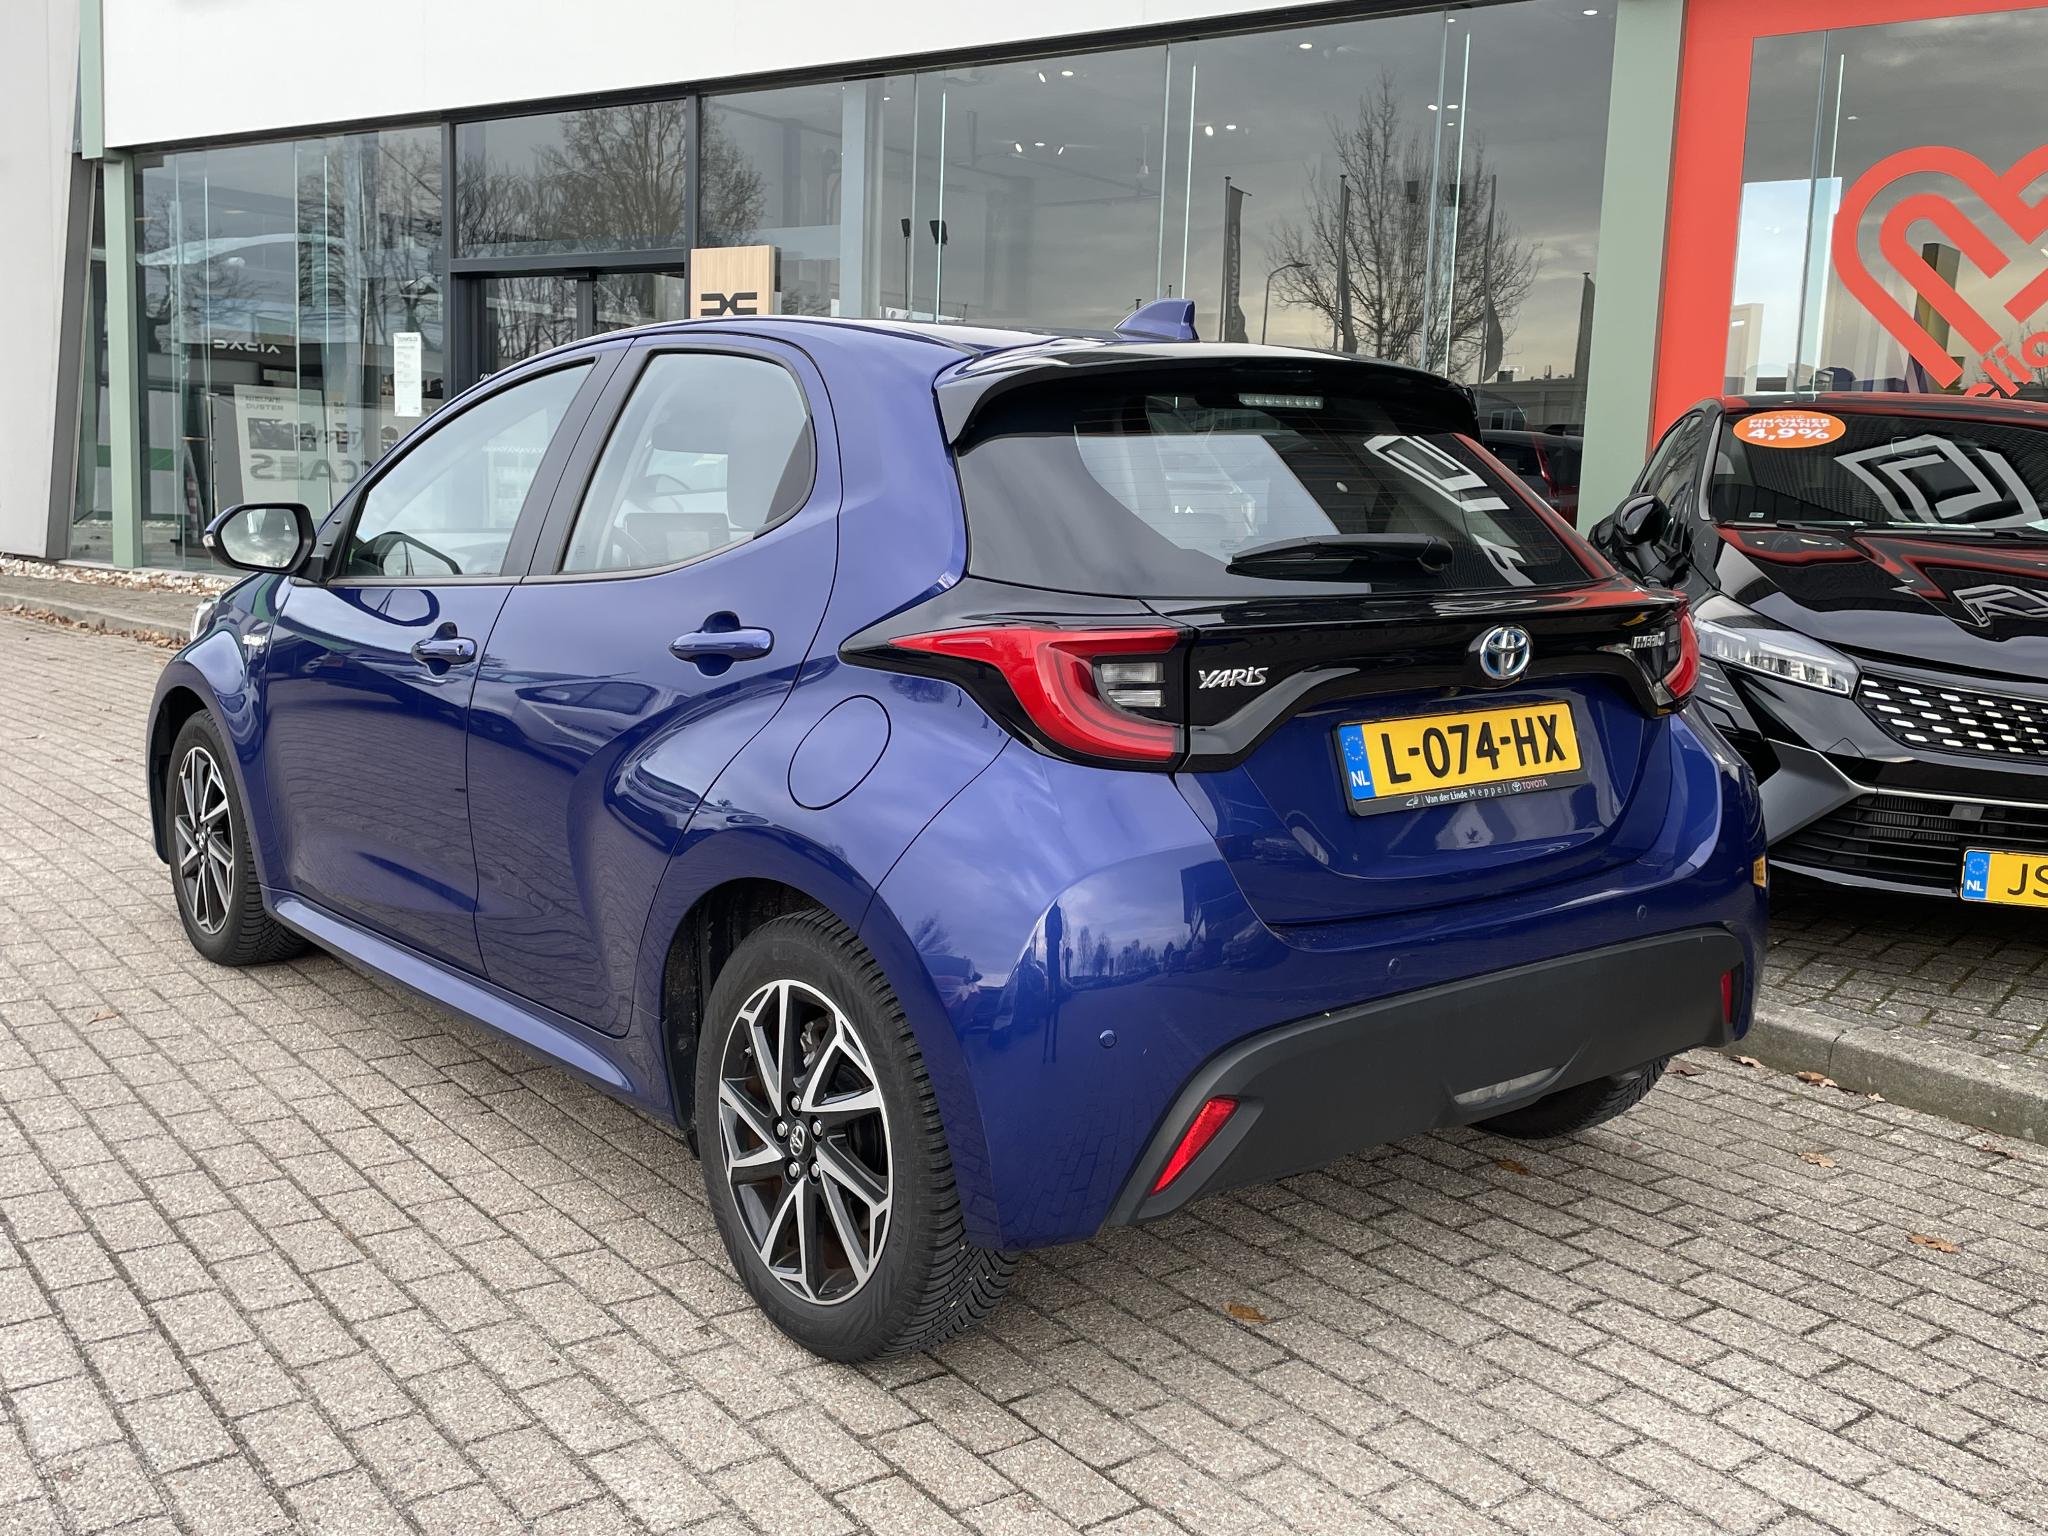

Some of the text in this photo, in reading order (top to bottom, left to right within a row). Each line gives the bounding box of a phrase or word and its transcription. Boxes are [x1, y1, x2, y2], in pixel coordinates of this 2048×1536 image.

[213, 339, 280, 354] DACIA
[1747, 428, 1830, 441] 4,9%
[1381, 714, 1566, 784] L-074-HX
[1351, 770, 1370, 787] NL
[1521, 779, 1548, 790] TOYOTA
[1425, 785, 1506, 804] Van der Linde Meppel
[1966, 880, 1985, 892] NL
